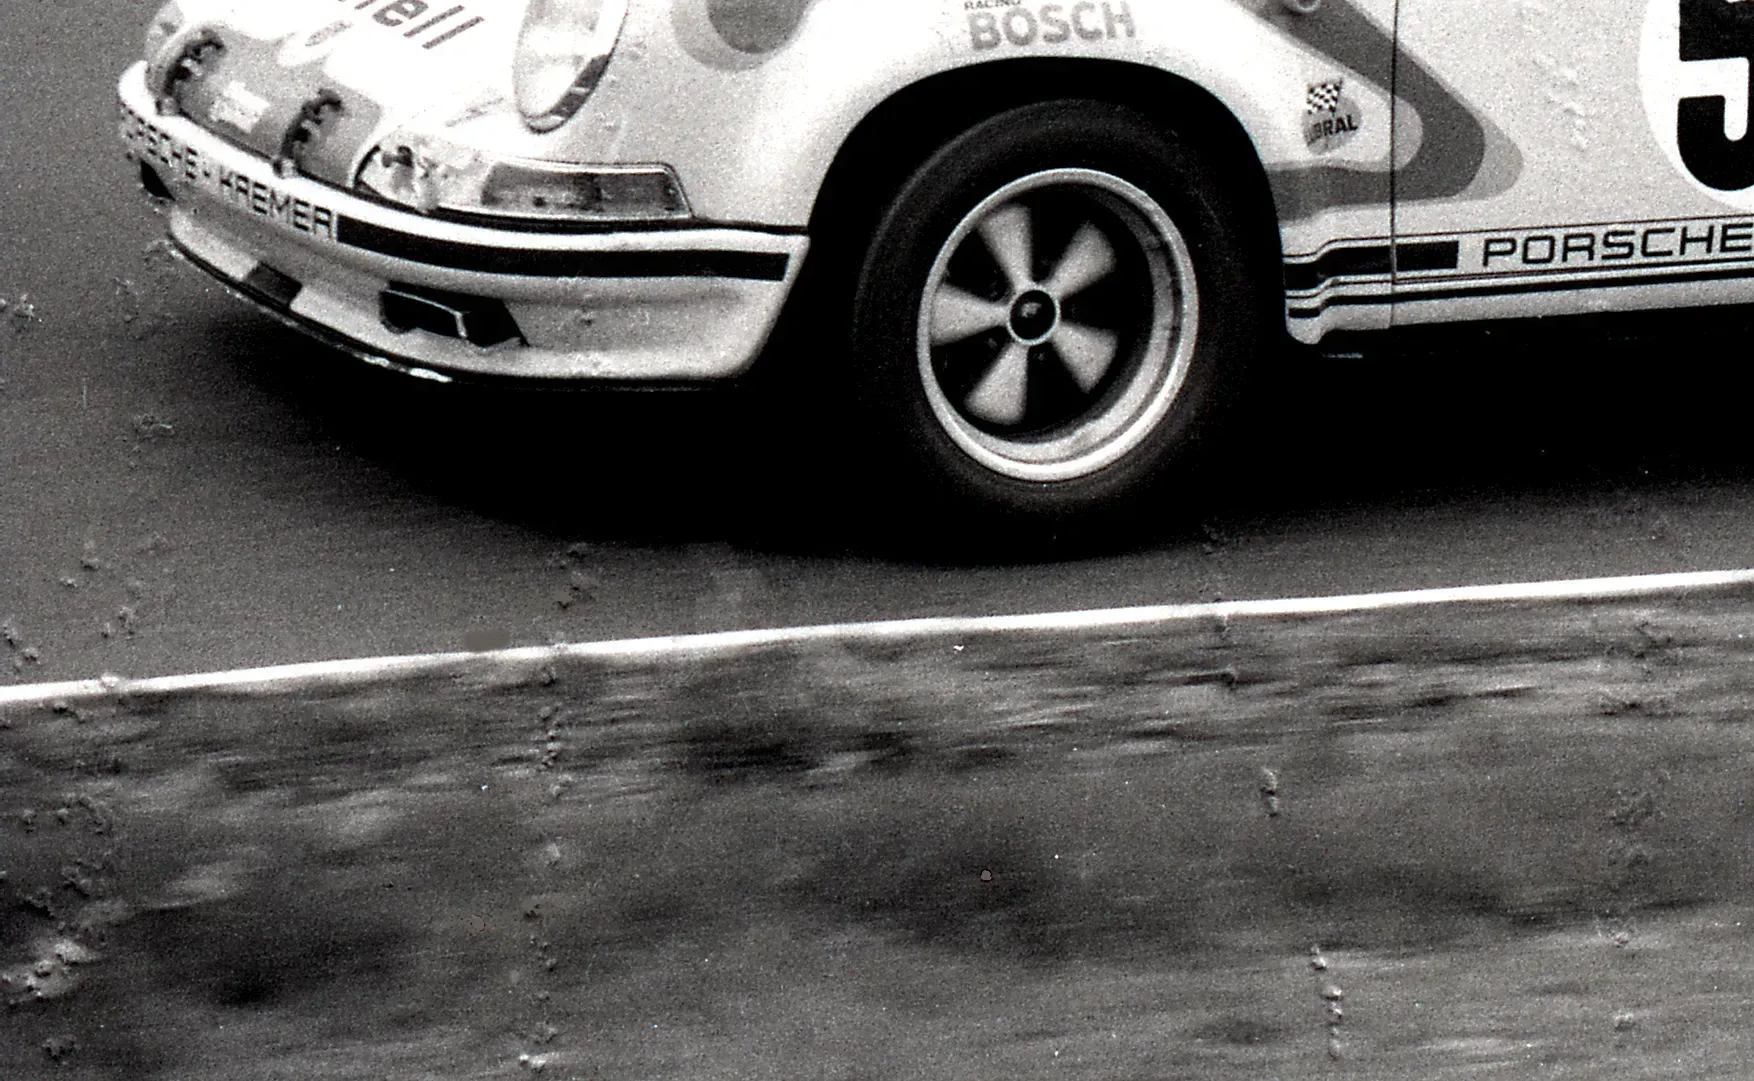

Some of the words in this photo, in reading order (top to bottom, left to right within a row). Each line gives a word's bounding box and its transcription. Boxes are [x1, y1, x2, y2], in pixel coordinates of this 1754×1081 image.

[966, 0, 1137, 52] BOSCH
[219, 166, 333, 240] KREMER
[1482, 222, 1754, 267] PORSCHE
